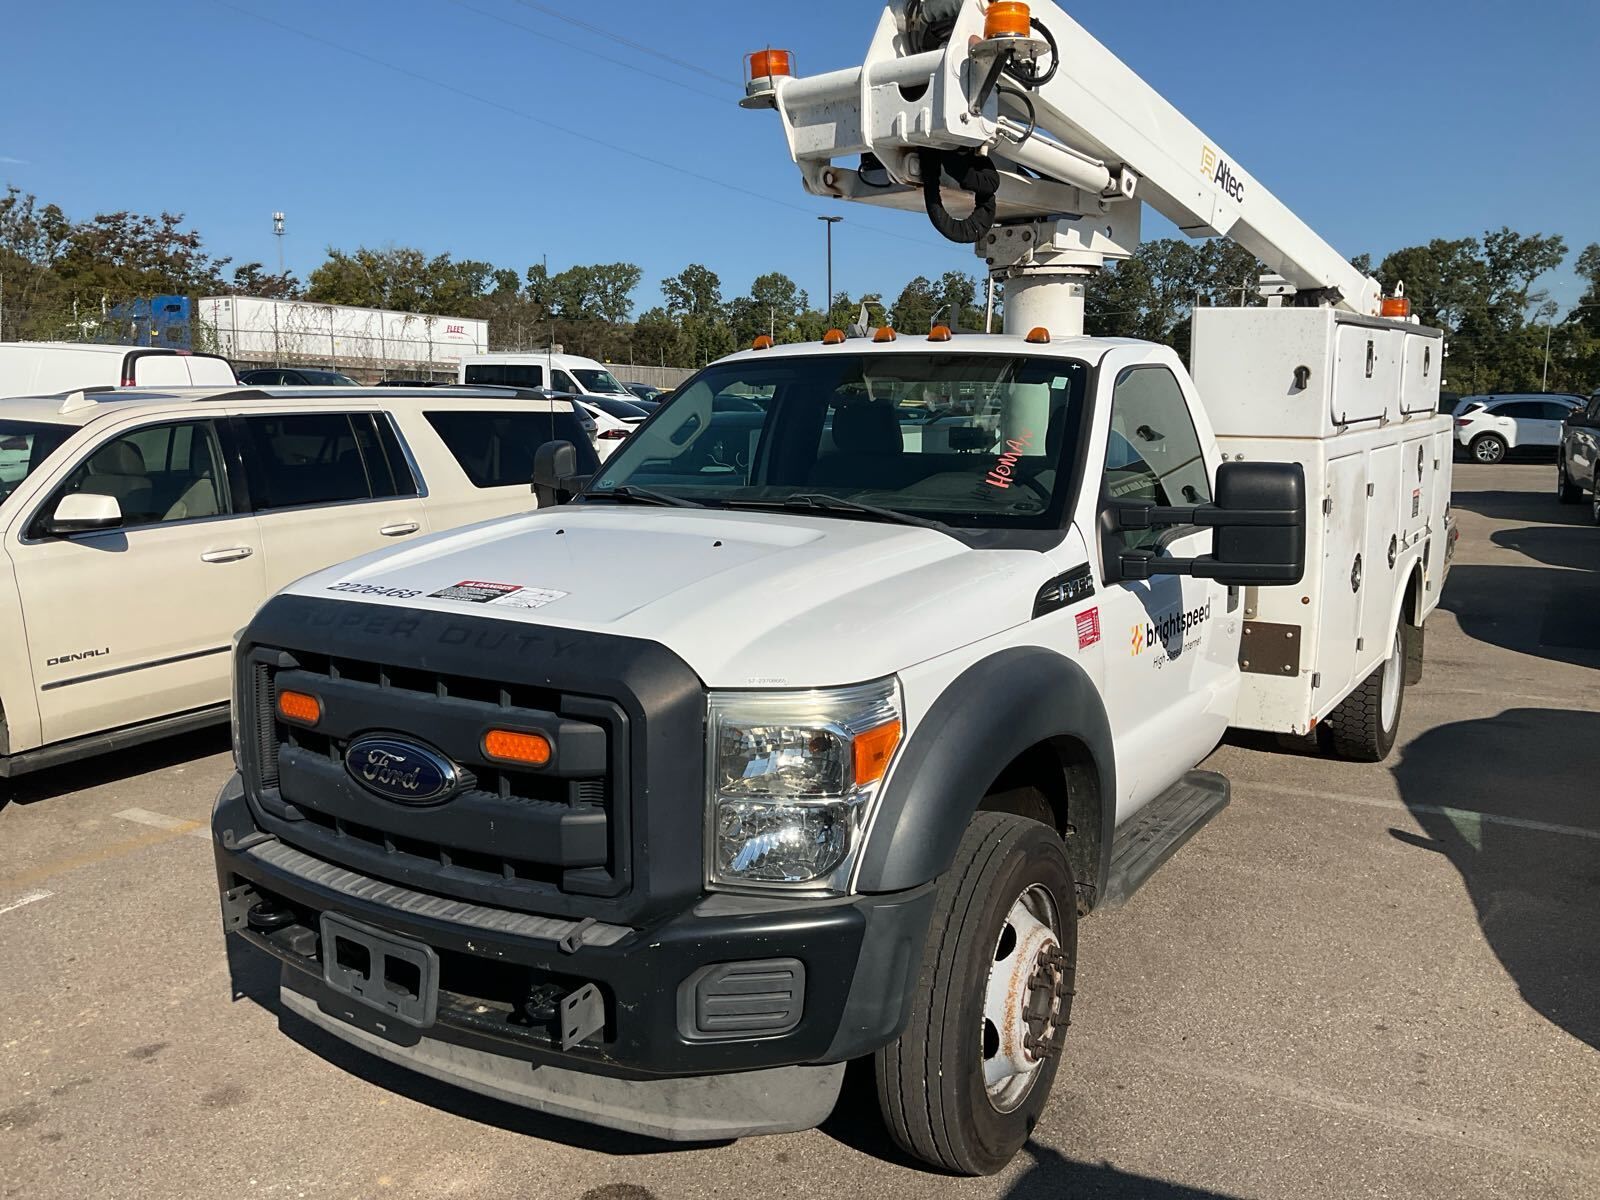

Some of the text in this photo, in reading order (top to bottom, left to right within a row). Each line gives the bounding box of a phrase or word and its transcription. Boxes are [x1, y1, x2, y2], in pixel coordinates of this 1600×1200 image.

[1214, 159, 1244, 203] Altec
[446, 325, 465, 334] FLEET
[326, 582, 422, 599] 2226468
[288, 608, 580, 659] SUPER DUTY
[1146, 596, 1210, 649] brightspeed
[47, 647, 110, 667] DENALI
[1153, 653, 1166, 670] High
[363, 749, 420, 790] Ford
